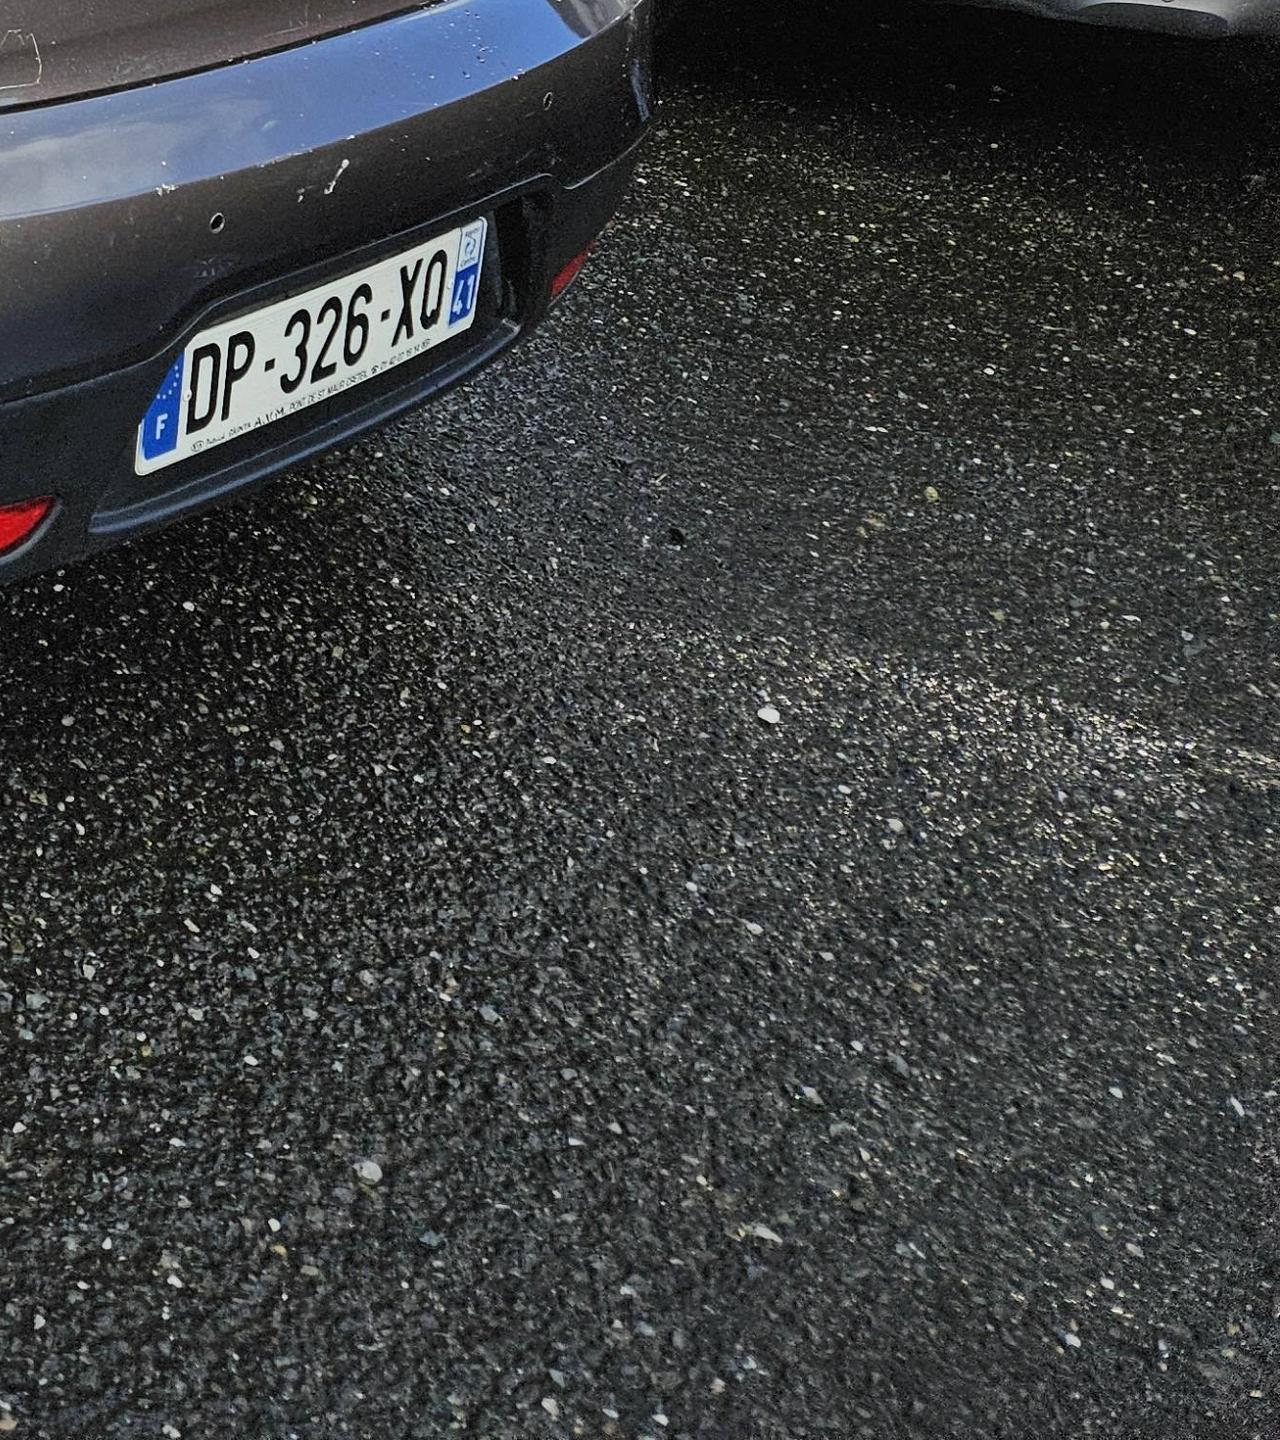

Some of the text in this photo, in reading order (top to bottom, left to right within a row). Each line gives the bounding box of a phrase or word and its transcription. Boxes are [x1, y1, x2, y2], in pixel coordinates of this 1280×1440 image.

[154, 412, 169, 441] F
[185, 248, 448, 435] DP-326-XQ
[452, 273, 476, 317] 41
